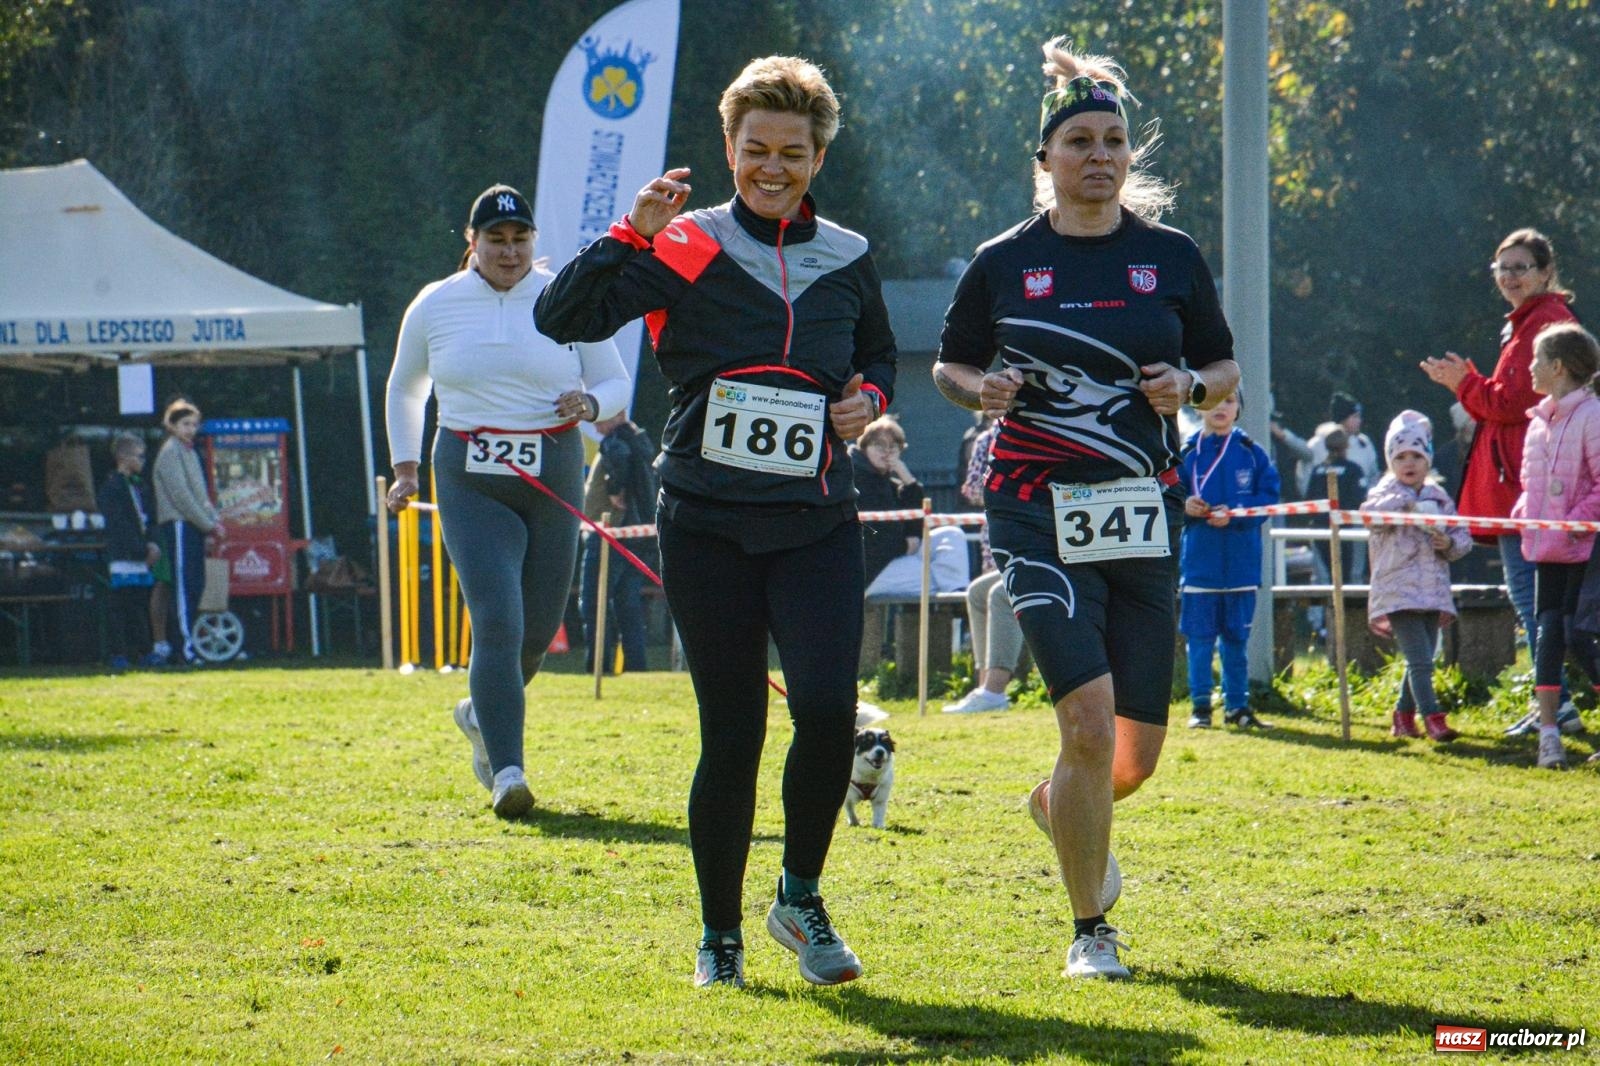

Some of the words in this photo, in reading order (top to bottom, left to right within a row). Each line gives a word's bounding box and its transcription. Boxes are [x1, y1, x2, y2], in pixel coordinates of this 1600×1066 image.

[36, 321, 69, 344] DLA
[86, 319, 174, 343] LEPSZEGO
[192, 318, 246, 342] JUTRA
[751, 395, 821, 412] www.personalbest.pl
[714, 411, 815, 461] 186
[472, 438, 537, 467] 325
[1063, 506, 1160, 548] 347
